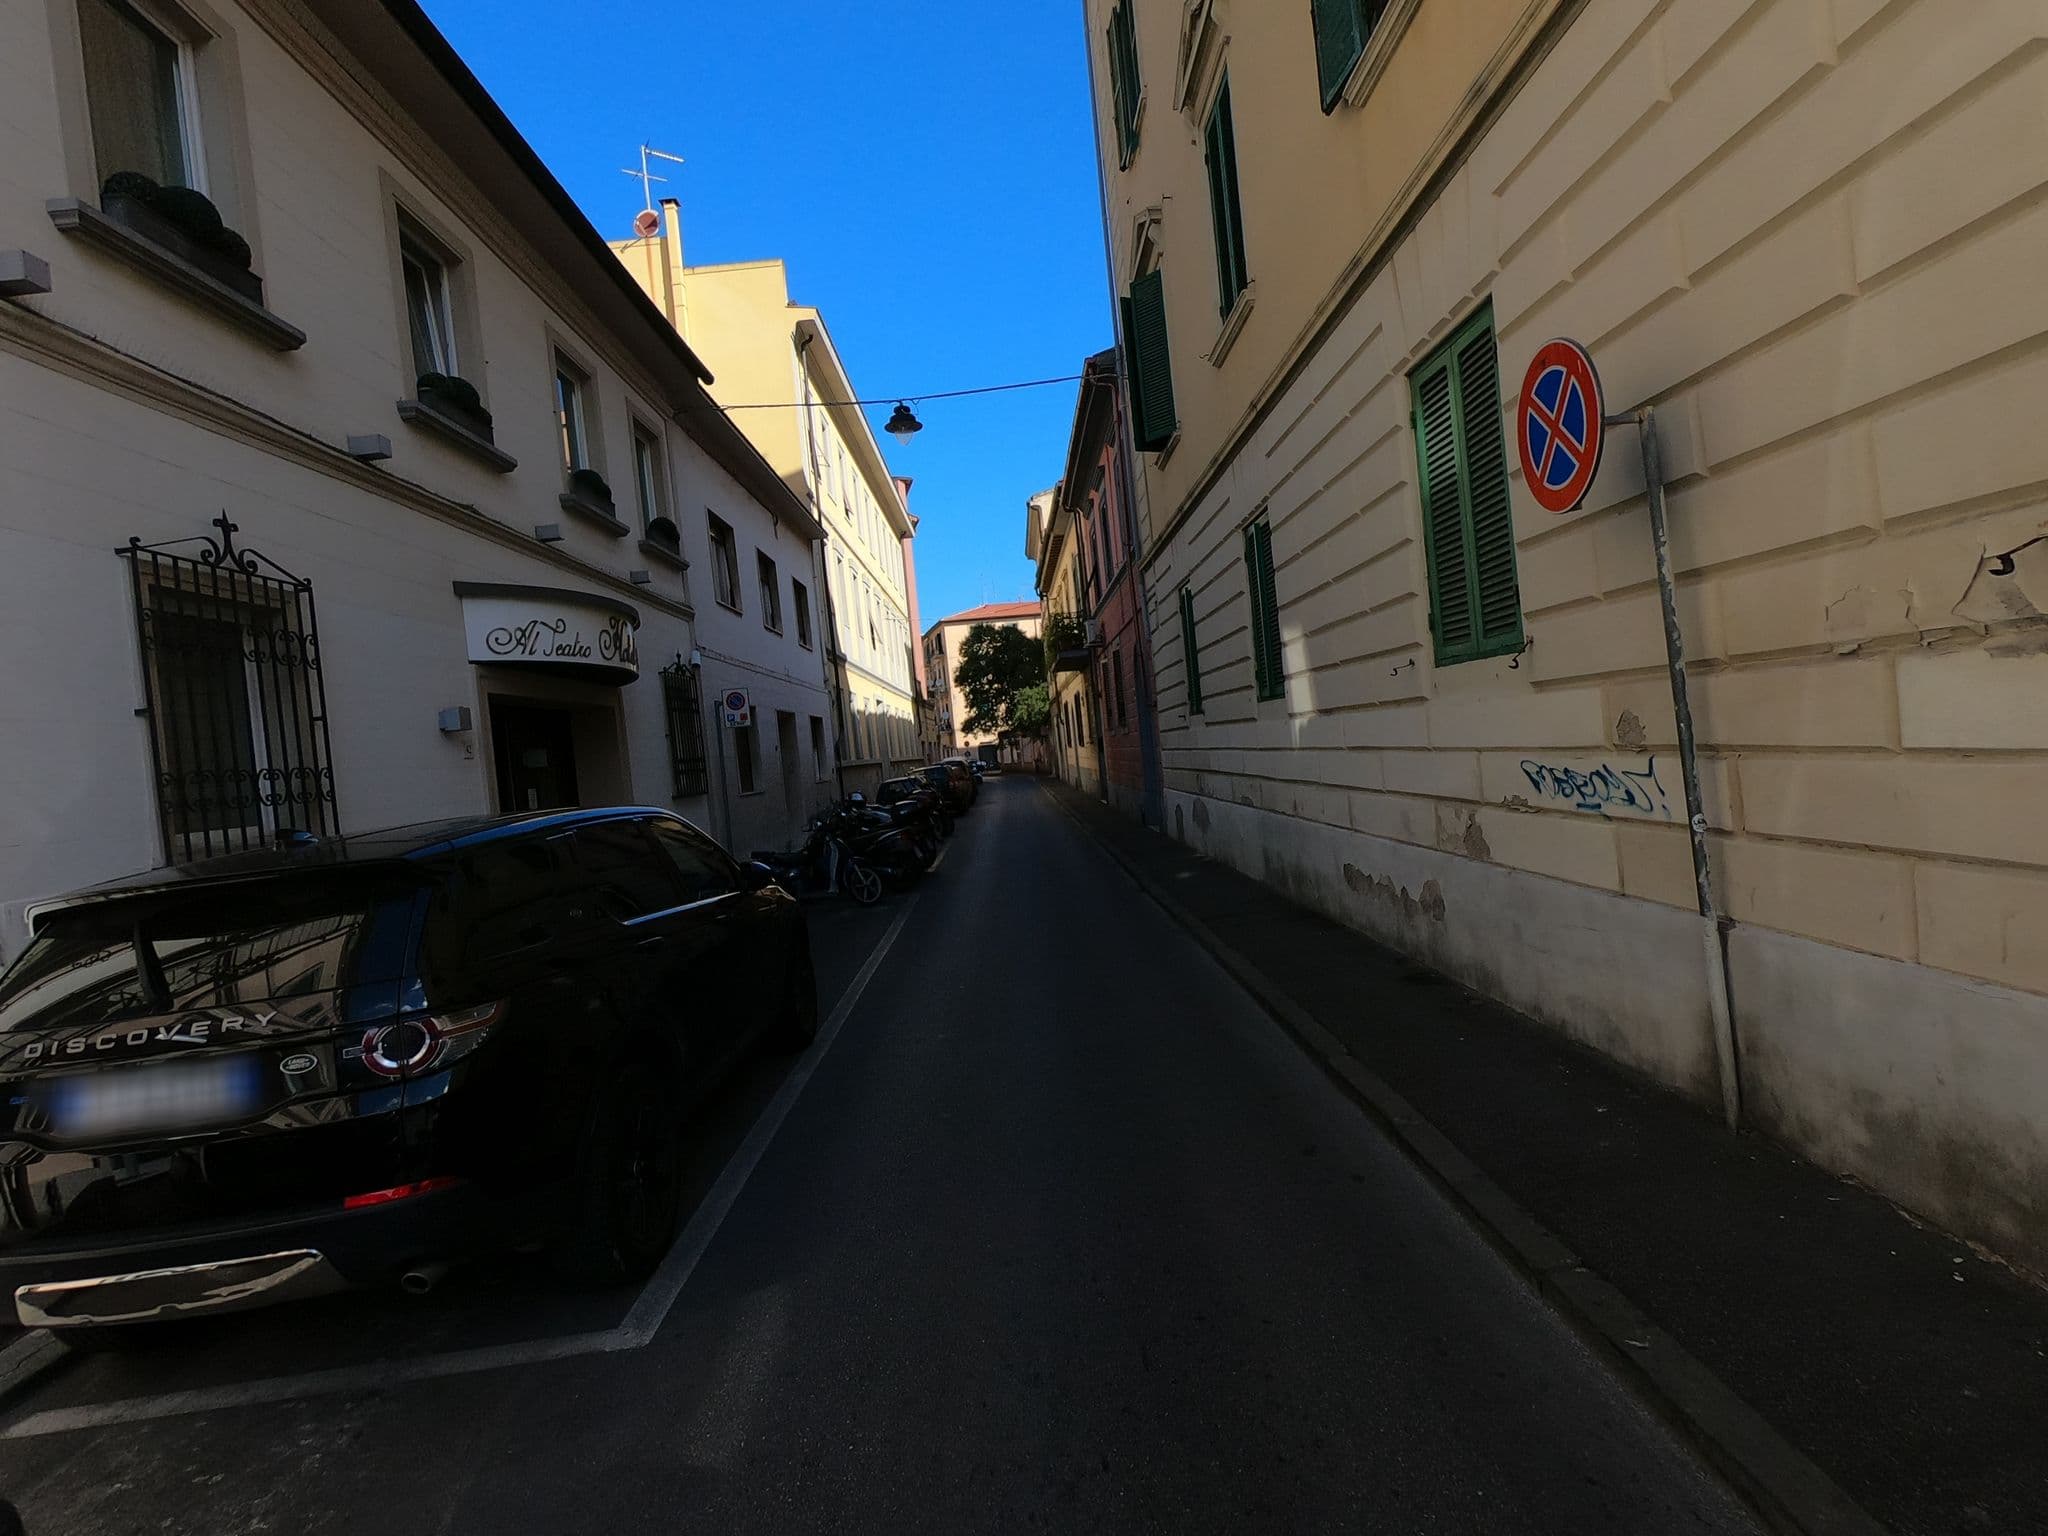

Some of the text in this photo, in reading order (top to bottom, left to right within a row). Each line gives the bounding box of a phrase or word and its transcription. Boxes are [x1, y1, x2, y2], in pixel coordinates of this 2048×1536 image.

[486, 619, 539, 655] Al
[540, 618, 591, 658] Teatro
[23, 1010, 278, 1059] DISCOVERY
